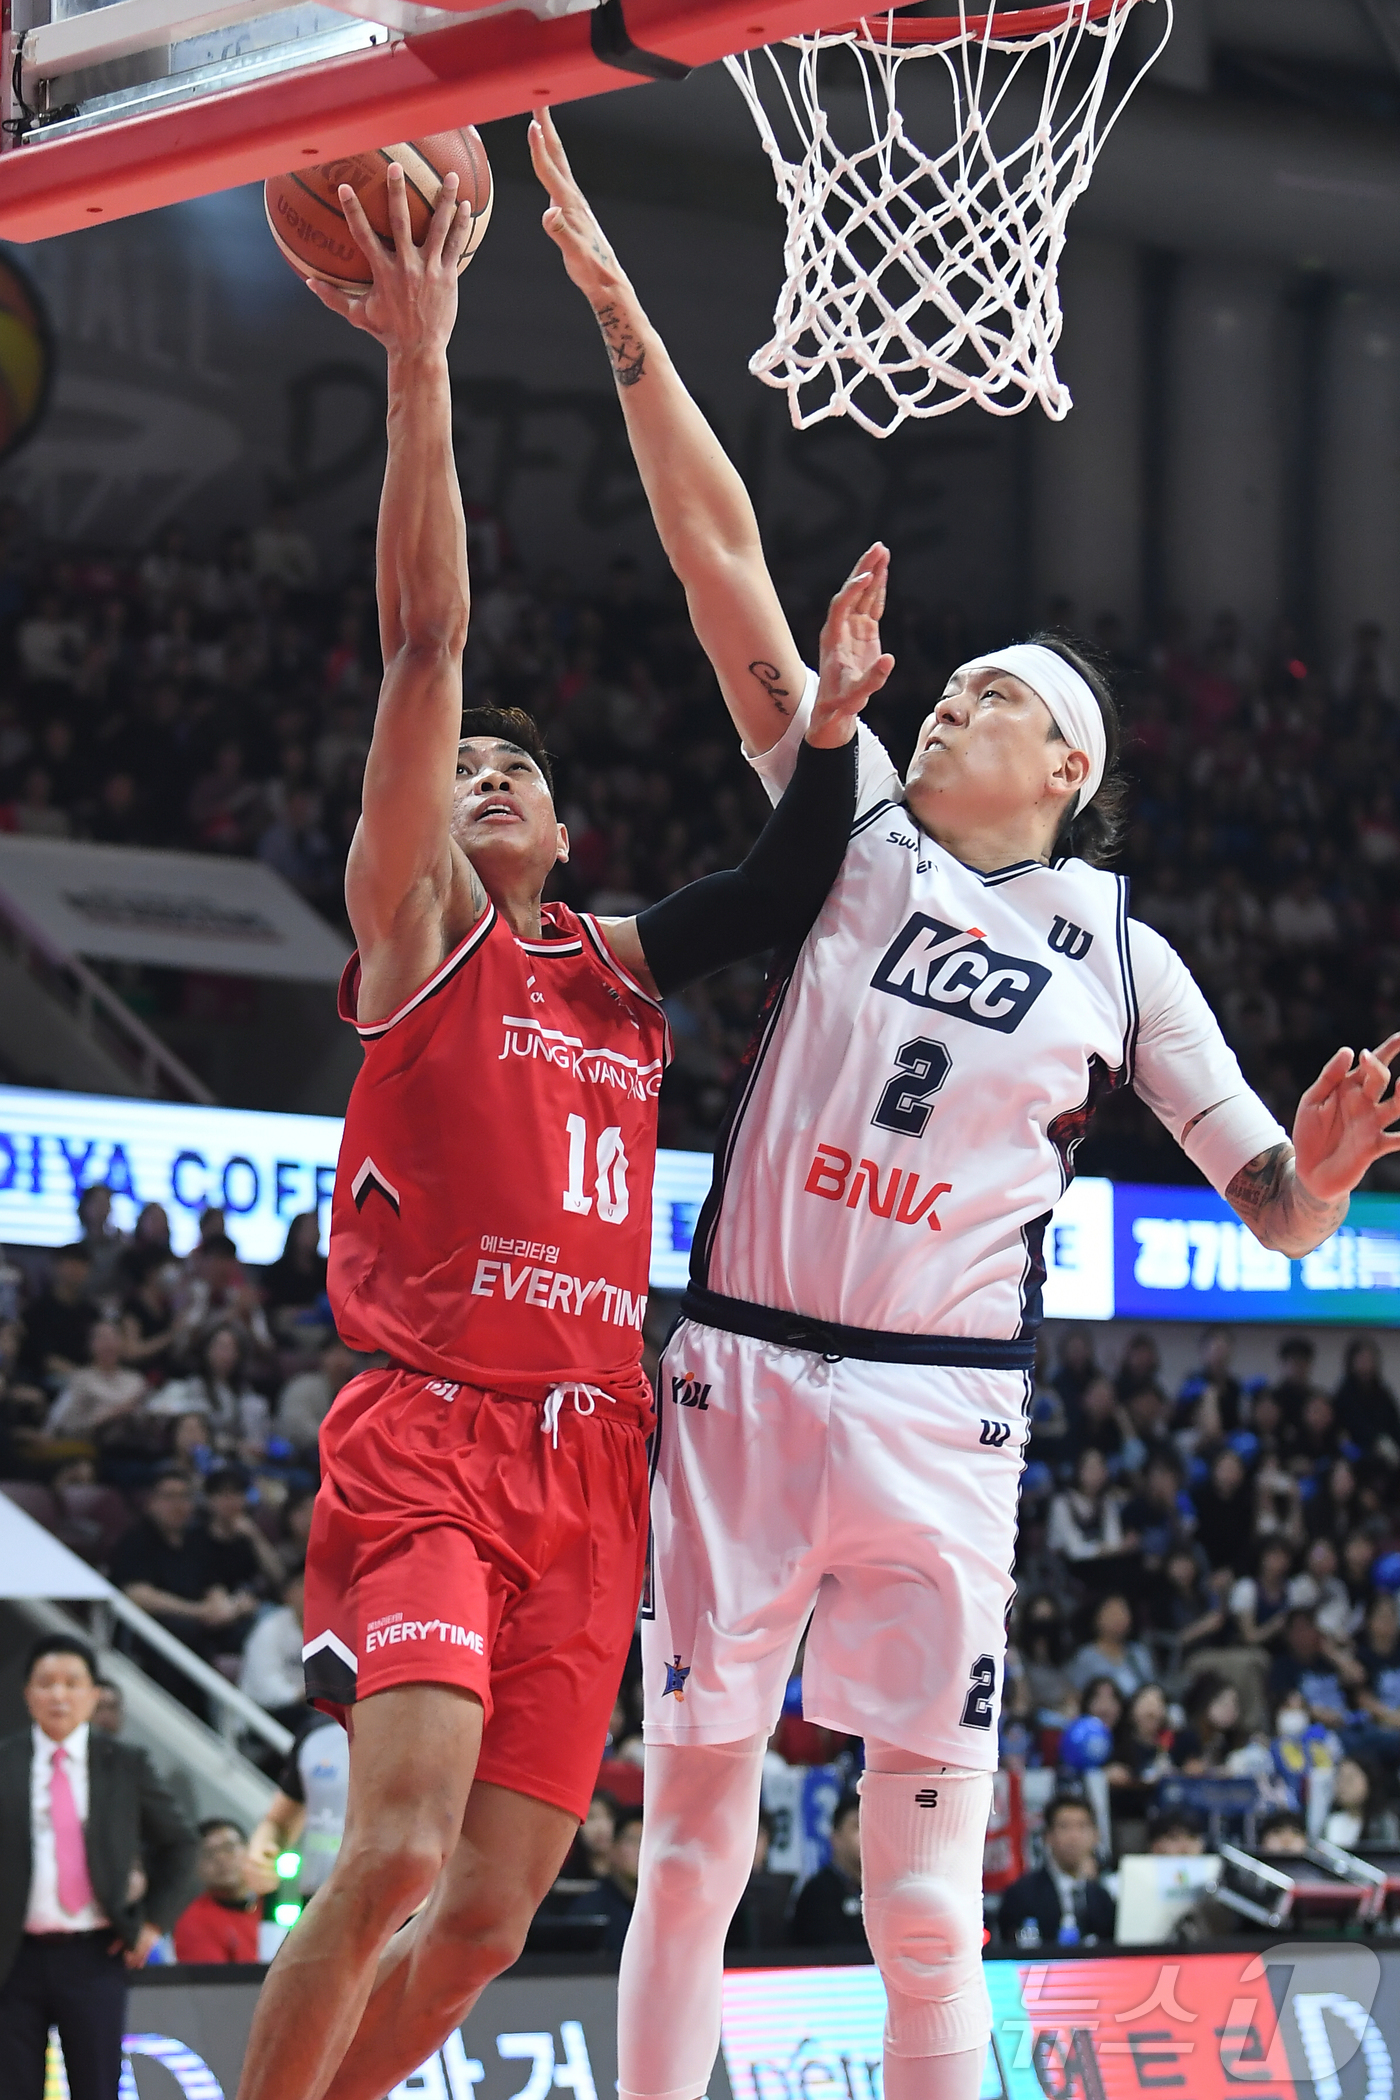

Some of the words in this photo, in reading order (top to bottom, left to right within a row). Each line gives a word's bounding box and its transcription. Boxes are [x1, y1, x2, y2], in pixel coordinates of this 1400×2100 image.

[277, 195, 355, 261] molten
[886, 926, 1031, 1019] KCC
[870, 1035, 954, 1139] 2
[562, 1112, 630, 1225] 10
[803, 1142, 953, 1232] BNK
[480, 1233, 561, 1265] 에브리타임
[958, 1653, 996, 1731] 2
